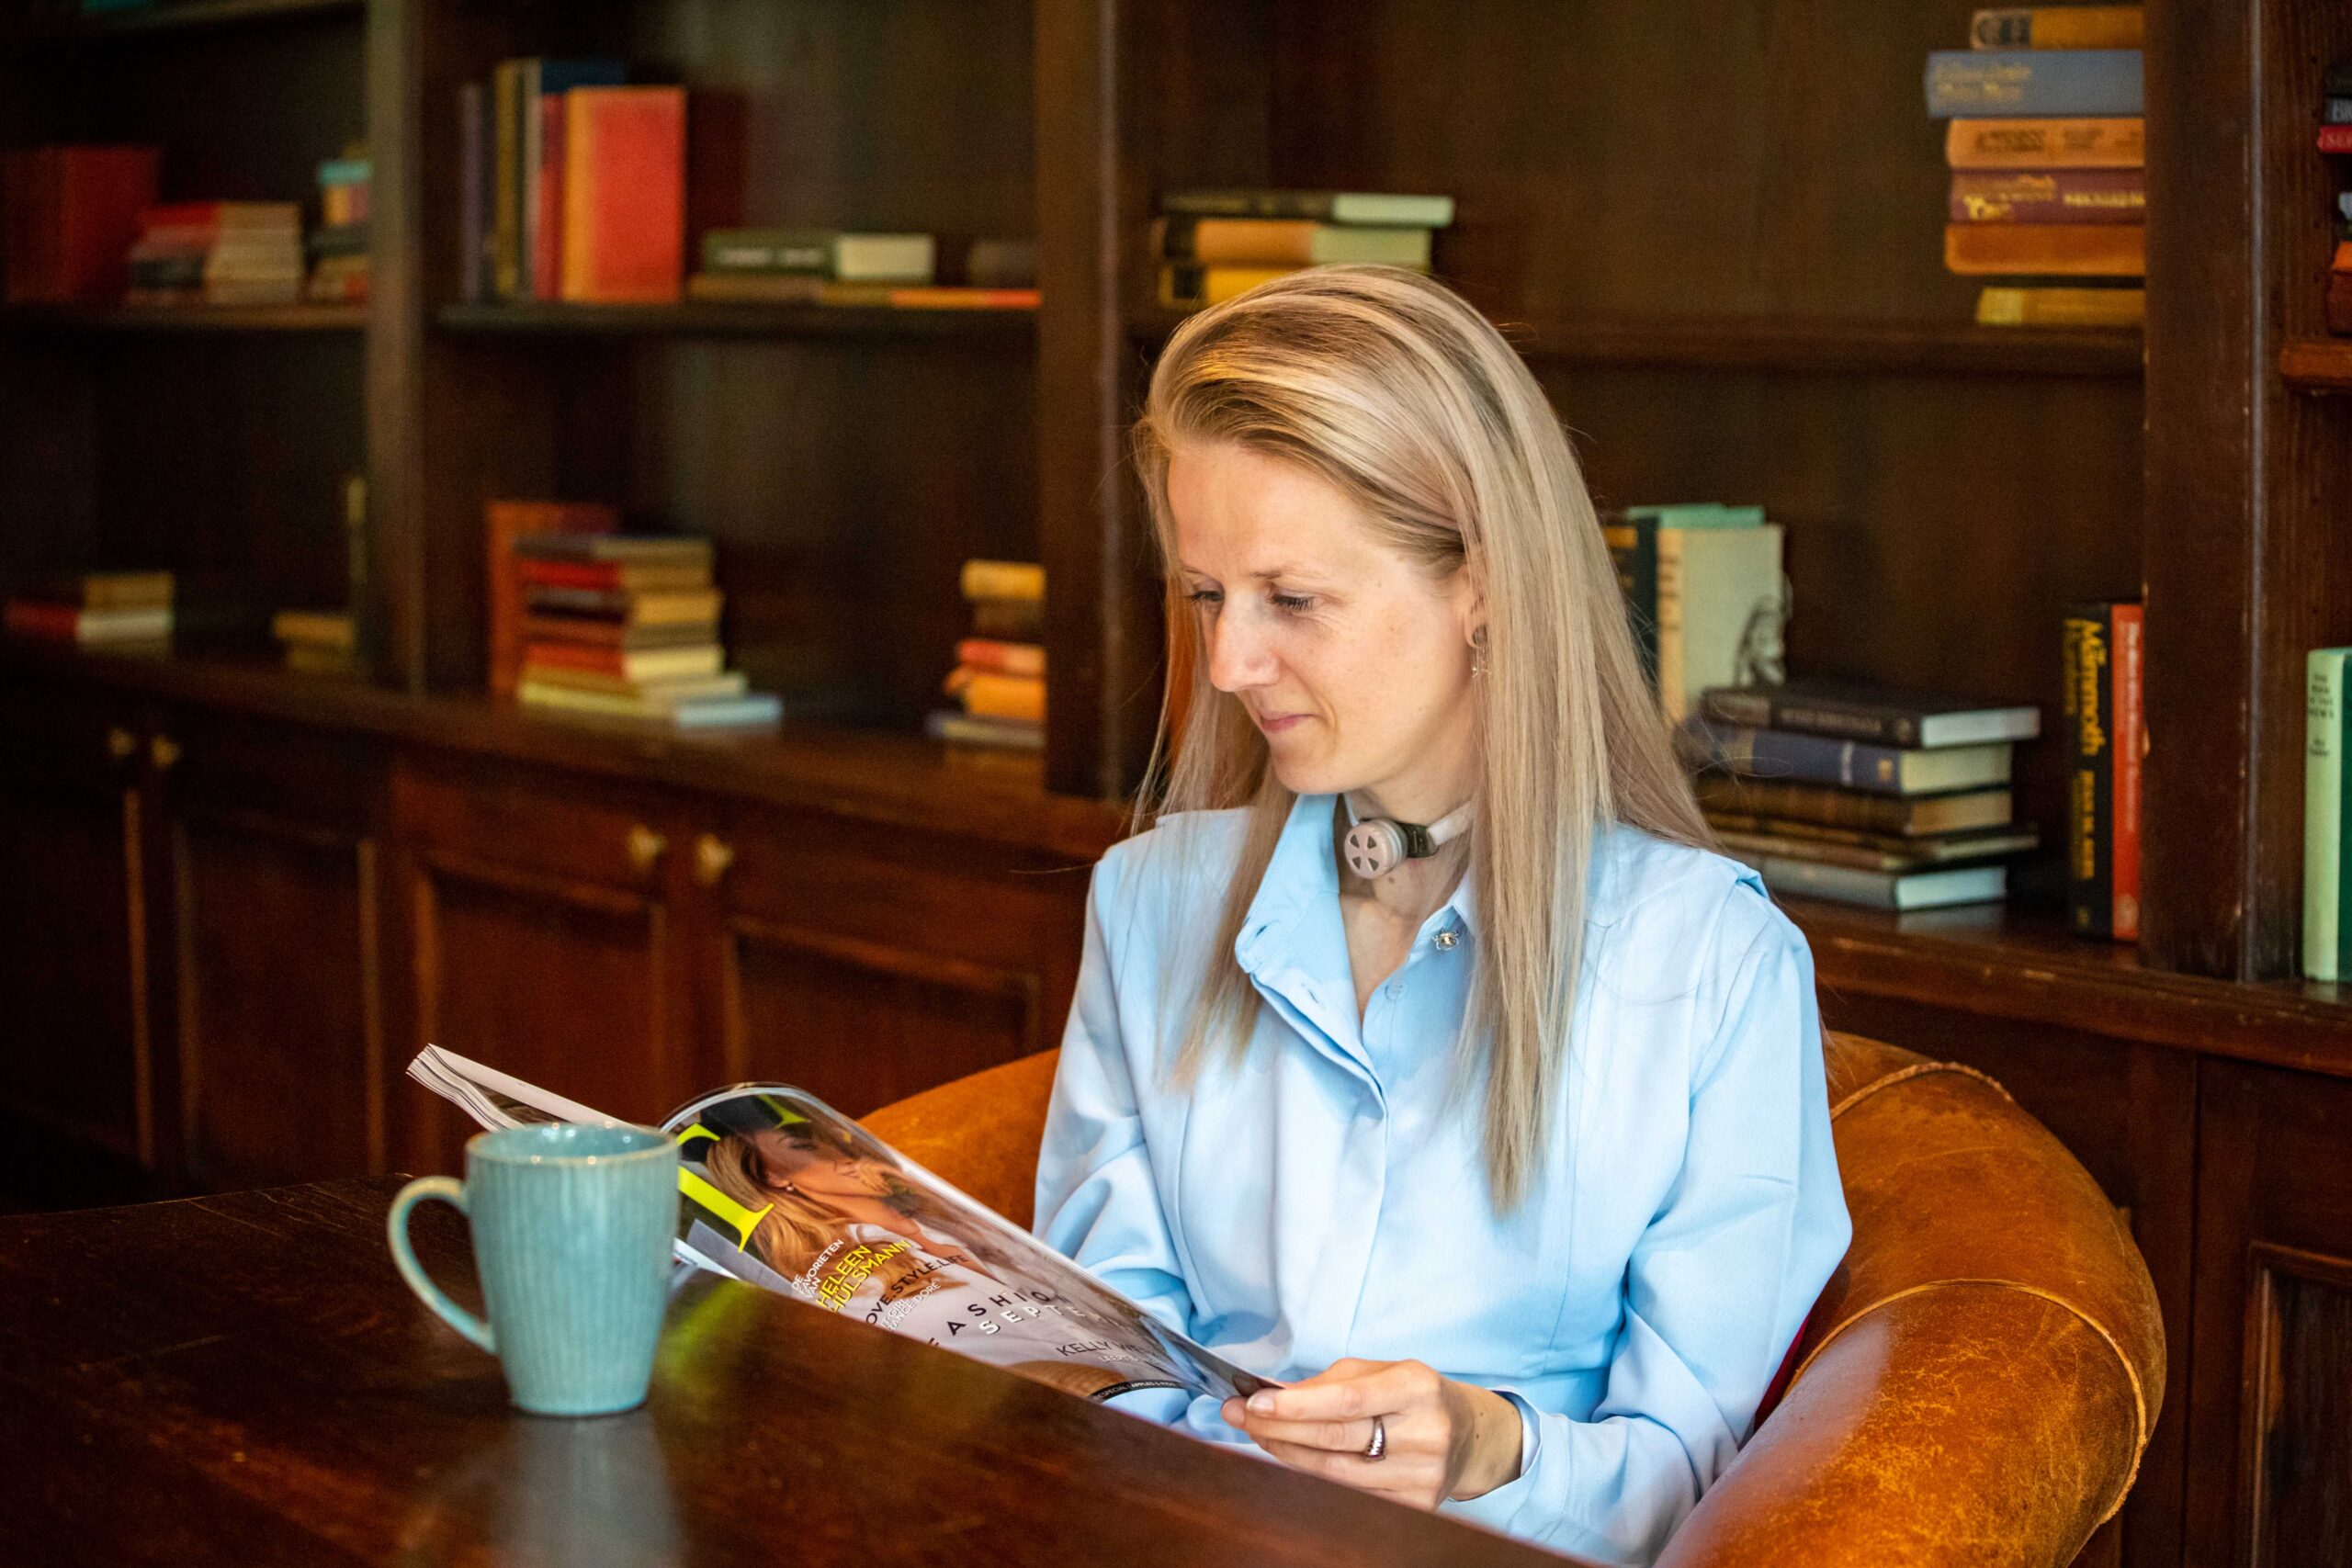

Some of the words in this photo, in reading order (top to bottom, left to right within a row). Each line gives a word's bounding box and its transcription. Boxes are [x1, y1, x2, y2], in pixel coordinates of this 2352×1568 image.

[791, 1274, 805, 1291] DE
[798, 1239, 844, 1295] FAVORIETEN
[816, 1245, 873, 1308] HELEEN
[802, 1277, 822, 1299] VAN
[865, 1254, 969, 1325] OVE.STYLE.LIFE
[888, 1299, 915, 1331] RANCE
[1055, 1340, 1113, 1357] KELLY
